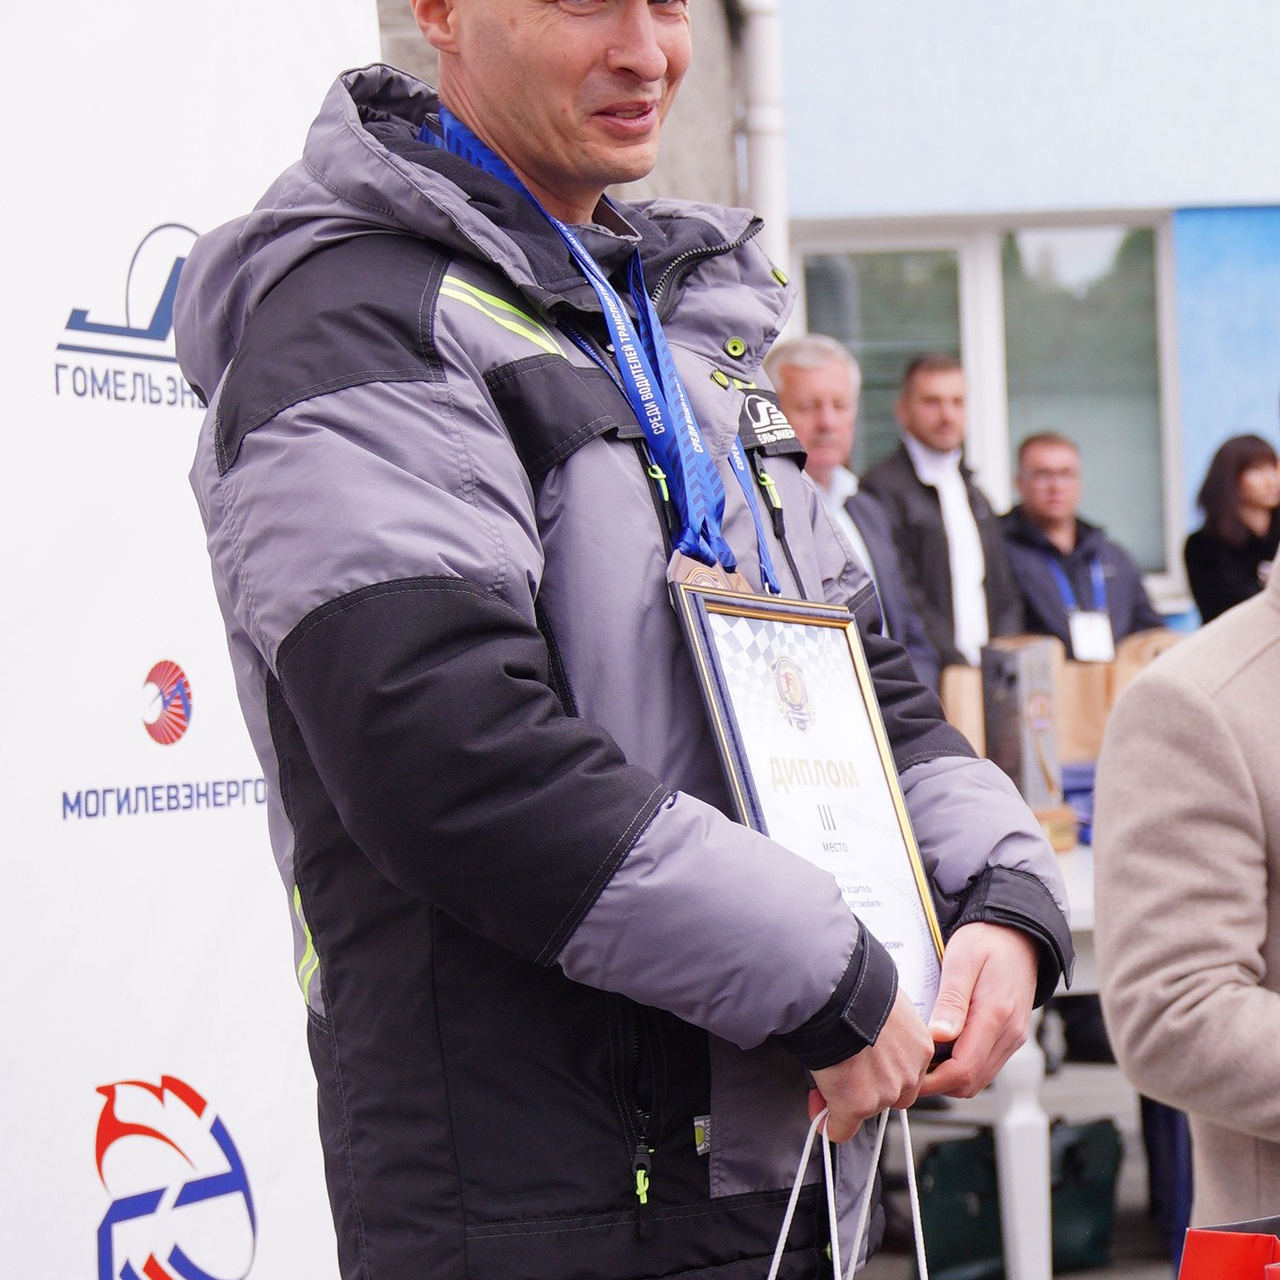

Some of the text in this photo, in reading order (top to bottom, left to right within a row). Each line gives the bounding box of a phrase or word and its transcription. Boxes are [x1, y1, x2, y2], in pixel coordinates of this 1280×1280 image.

[625, 343, 654, 402] ВОДИТЕЛЕЙ
[646, 403, 666, 435] СРЕДИ
[769, 757, 861, 794] ДИПЛОМ
[62, 778, 268, 820] МОГИЛЕВЭНЕРГО
[823, 842, 848, 853] место
